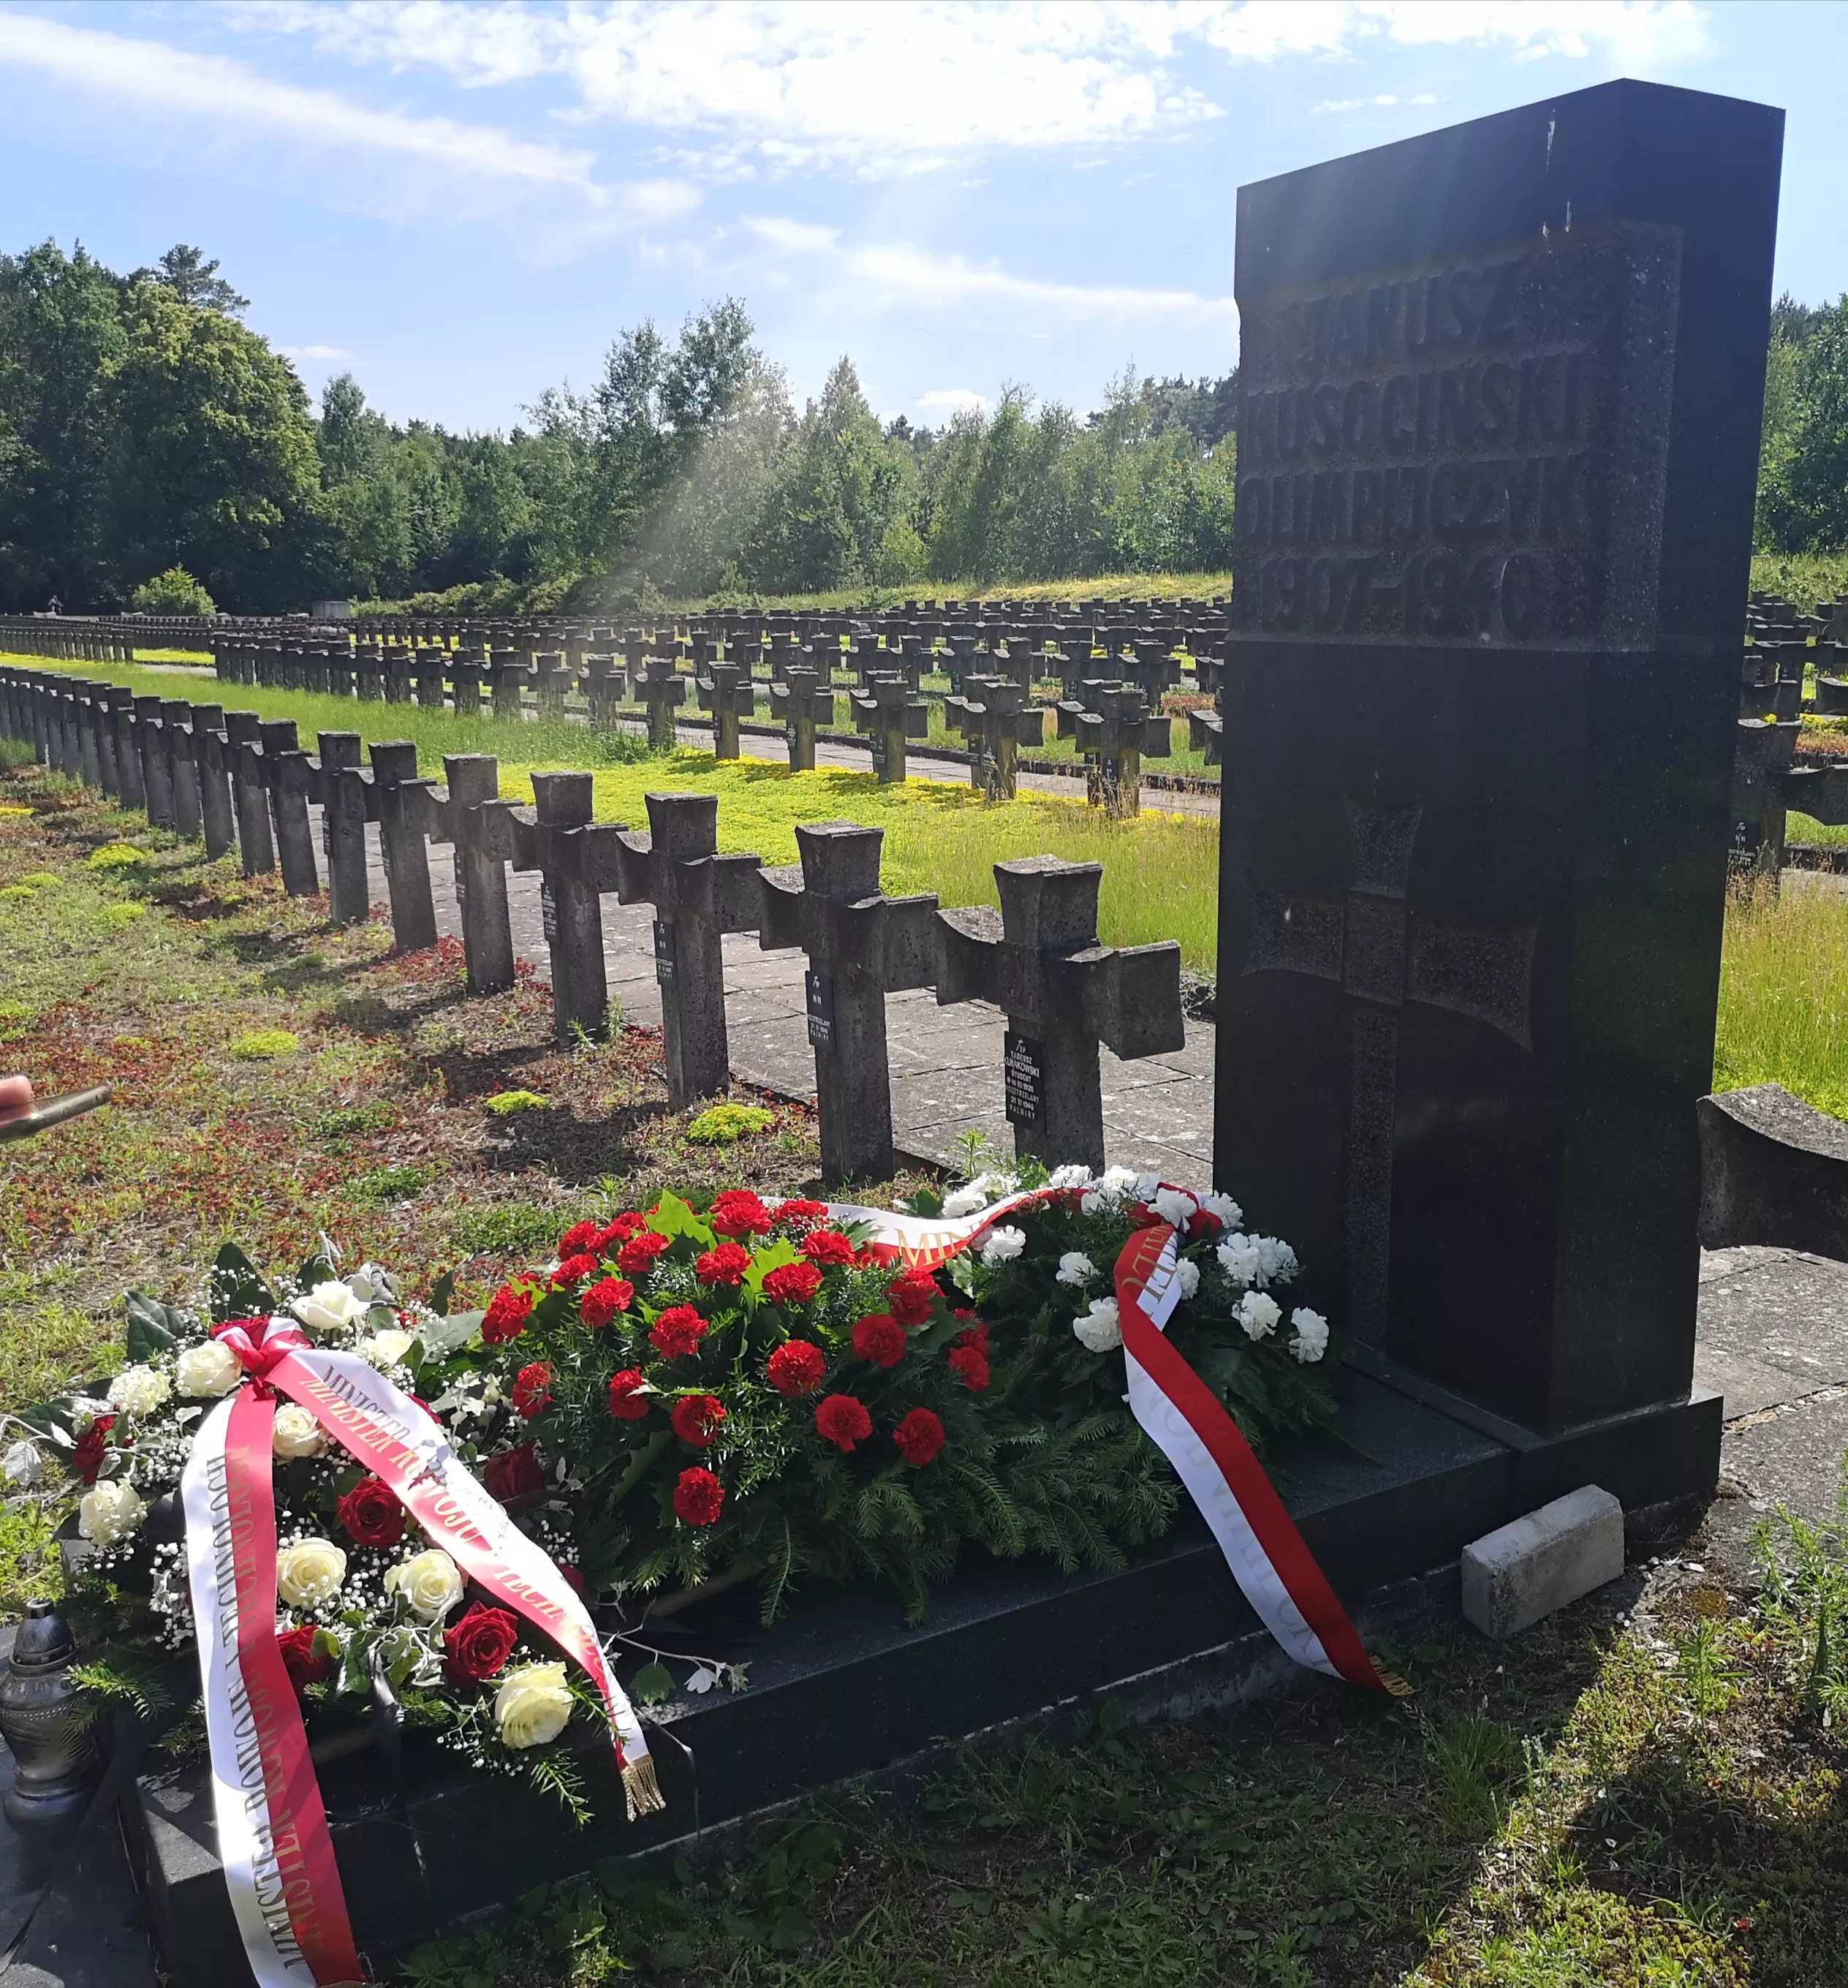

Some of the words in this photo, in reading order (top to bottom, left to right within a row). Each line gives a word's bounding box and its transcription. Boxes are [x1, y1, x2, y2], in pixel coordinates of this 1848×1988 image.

[1297, 260, 1521, 366] JANUSZ
[1237, 451, 1594, 545] OLIMPIJCZYK
[1010, 1050, 1032, 1065] TADEUSZ
[1011, 1069, 1031, 1083] STUDENT
[1010, 1103, 1035, 1120] PALMIRY
[299, 1364, 412, 1453] MINISTER
[206, 1445, 257, 1648] TECHNOLOGII
[250, 1806, 324, 1970] MINISTER
